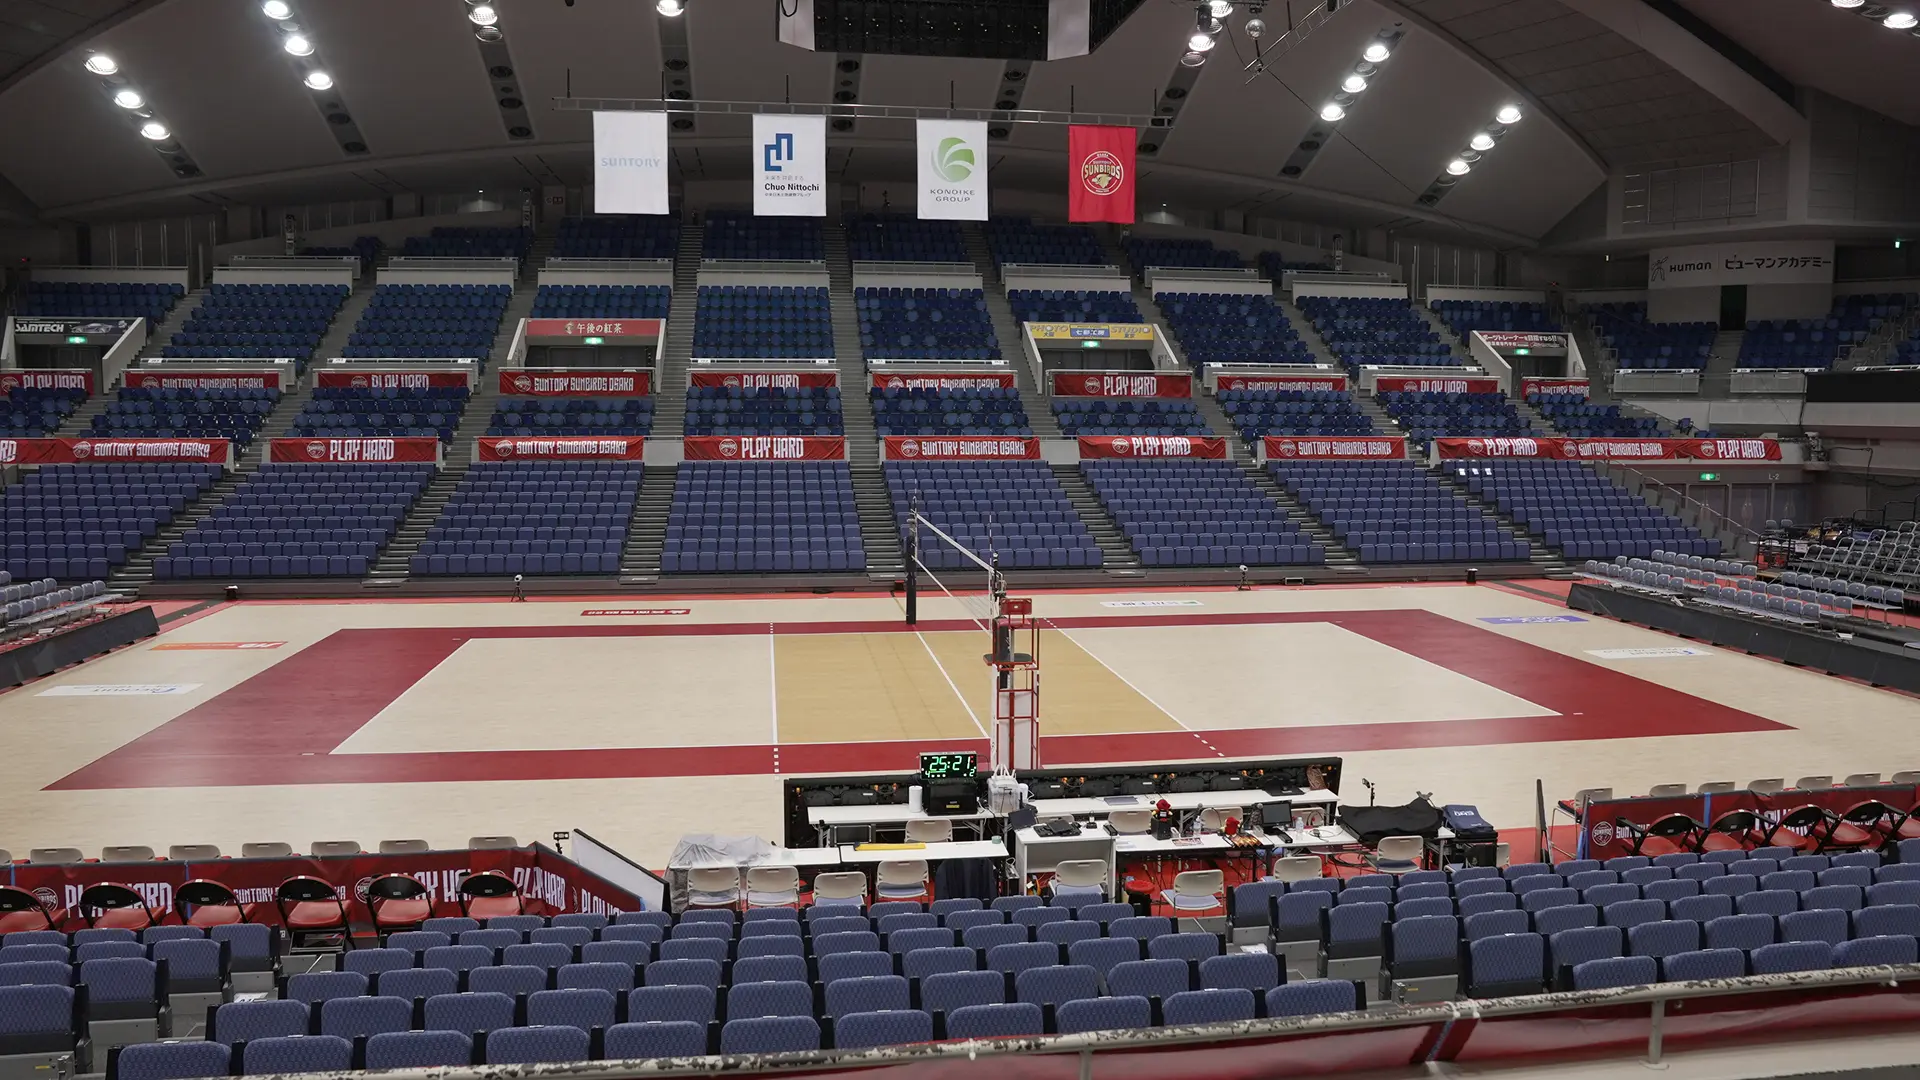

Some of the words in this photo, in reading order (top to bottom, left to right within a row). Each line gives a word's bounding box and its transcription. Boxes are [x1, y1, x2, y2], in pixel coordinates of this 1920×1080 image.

[601, 157, 660, 167] SUNTORY
[1084, 164, 1120, 180] SUNBIRDS
[764, 183, 785, 191] Chuo
[788, 183, 819, 192] Nittochi
[15, 324, 64, 333] SAMTECH
[577, 323, 622, 333] 午後の紅茶
[534, 378, 568, 391] SUNTORY
[570, 377, 607, 391] SUNBIRDS
[609, 377, 634, 391] OSAKA
[743, 375, 769, 391] PLAY
[1104, 376, 1128, 395] PLAY
[1131, 376, 1156, 395] HARD
[94, 442, 135, 457] SUNTORY
[136, 442, 179, 457] SUNBIRDS
[181, 443, 211, 458] OSAKA
[330, 440, 360, 460] PLAY
[363, 440, 394, 460] HARD
[516, 441, 556, 455] SUNTORY
[557, 441, 597, 454] SUNBIRDS
[599, 441, 627, 454] OSAKA
[741, 438, 770, 458] PLAY
[773, 438, 804, 458] HARD
[922, 441, 958, 455] SUNTORY
[960, 441, 997, 455] SUNBIRDS
[999, 441, 1025, 455] OSAKA
[1131, 437, 1160, 456] PLAY
[1161, 437, 1191, 455] HARD
[1298, 441, 1331, 455] SUNTORY
[1332, 441, 1367, 455] SUNBIRDS
[1368, 441, 1391, 455] OSAKA
[1483, 439, 1510, 456] PLAY
[1511, 439, 1538, 455] HARD
[1578, 443, 1609, 456] SUNTORY
[1610, 443, 1641, 456] SUNBIRDS
[1642, 443, 1663, 456] OSAKA
[1716, 440, 1740, 458] PLAY
[1741, 440, 1765, 458] HARD
[929, 756, 971, 771] 25:21
[969, 769, 975, 777] 2
[512, 867, 545, 899] PLAY
[544, 870, 566, 911] HARD
